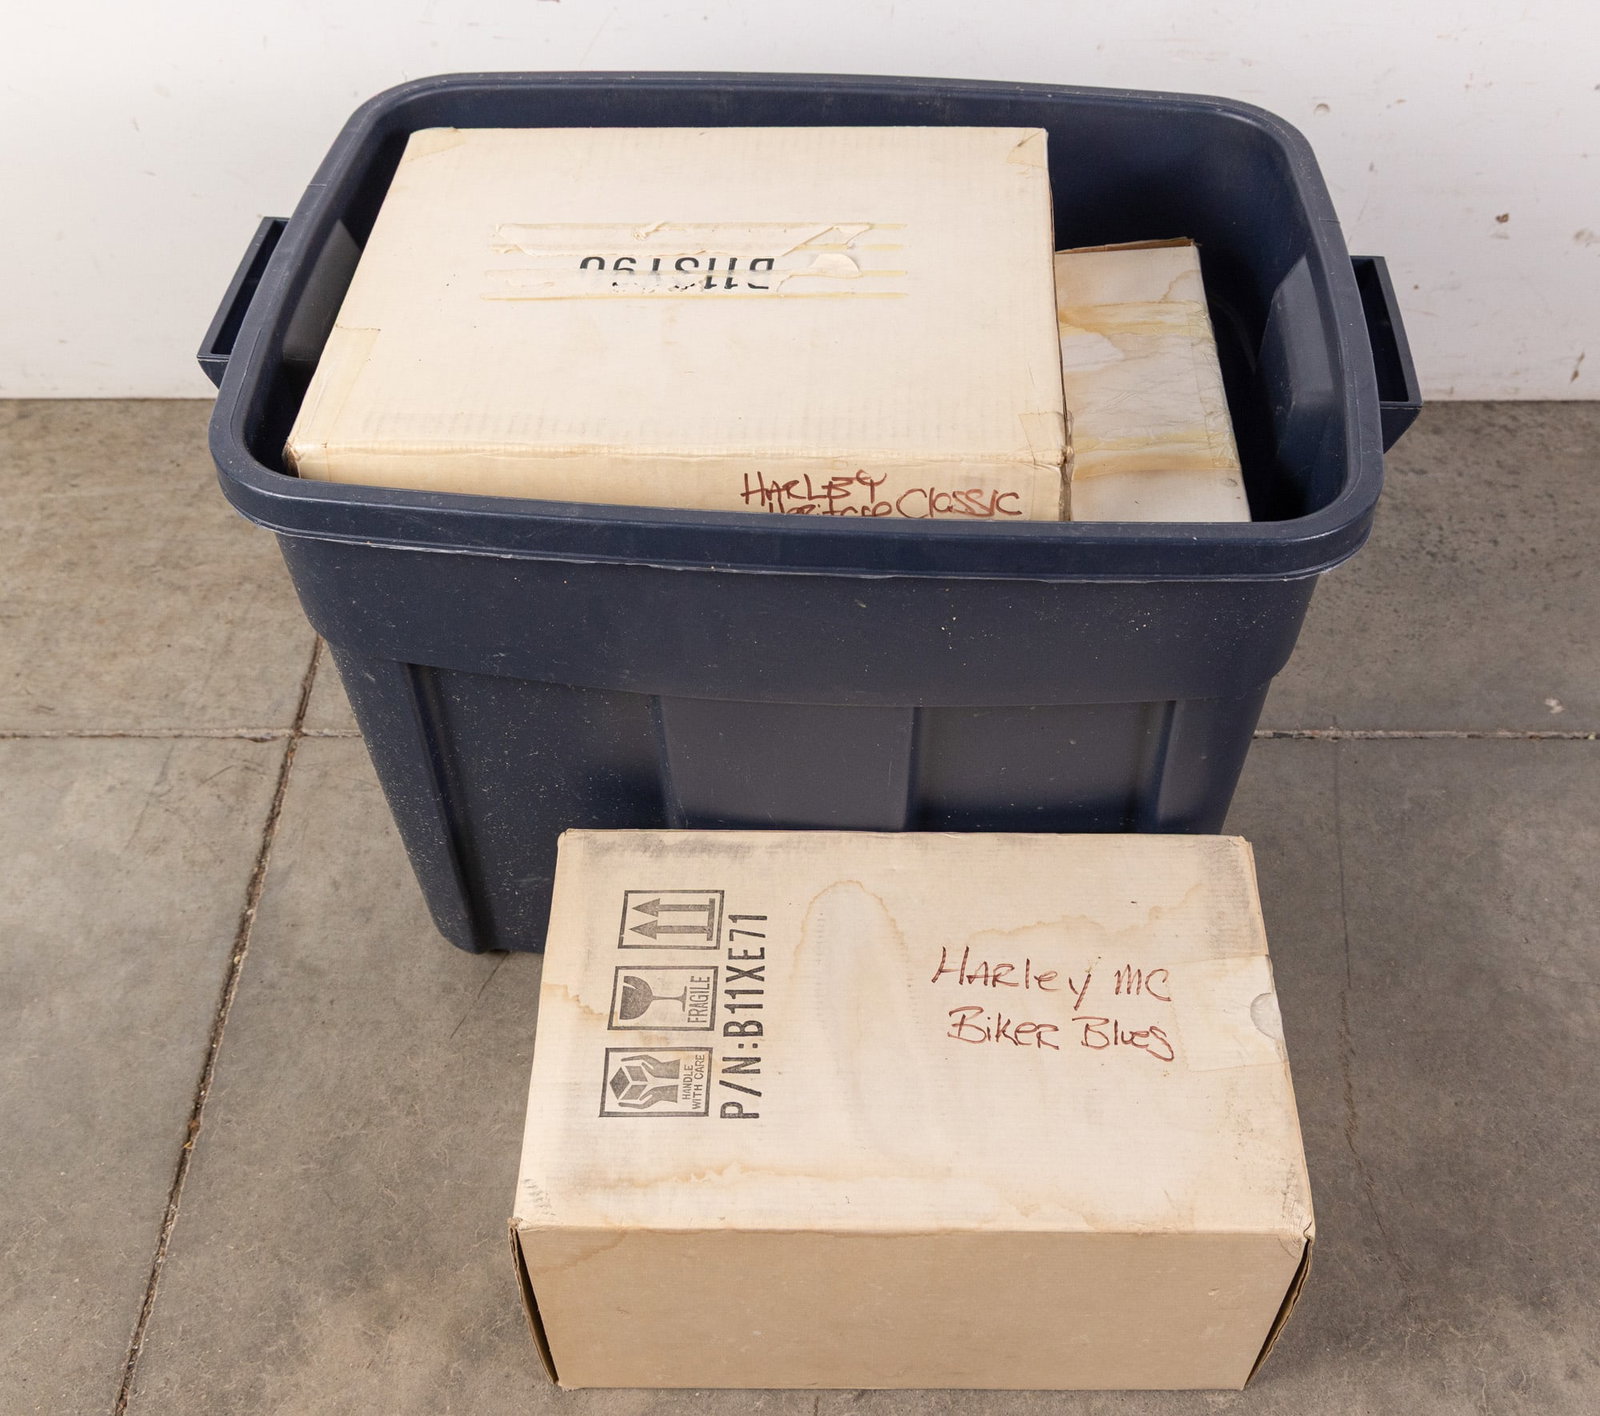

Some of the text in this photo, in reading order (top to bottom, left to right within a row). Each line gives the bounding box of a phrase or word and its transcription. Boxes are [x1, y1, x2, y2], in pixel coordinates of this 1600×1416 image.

[687, 975, 711, 1024] FRAGILE
[719, 914, 768, 1119] P/N:B11XE71
[1071, 1015, 1175, 1062] Blues
[682, 1064, 694, 1100] HANDLE
[692, 1054, 706, 1110] WITH CARE
